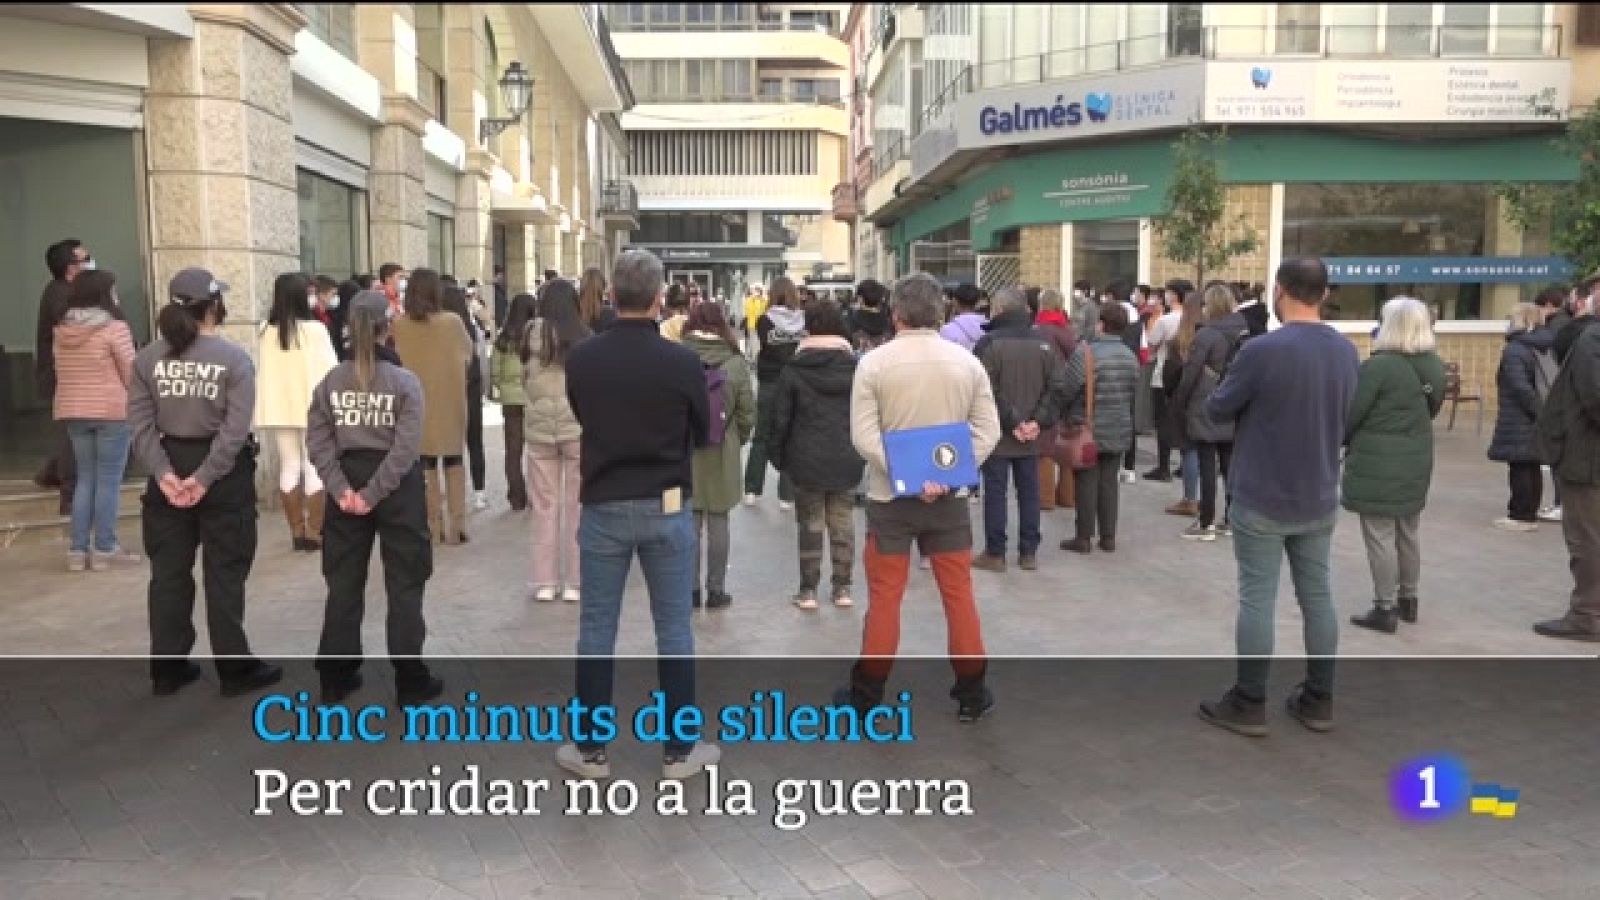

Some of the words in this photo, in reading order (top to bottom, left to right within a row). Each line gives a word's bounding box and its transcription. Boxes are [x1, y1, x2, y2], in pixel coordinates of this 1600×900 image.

[980, 95, 1082, 136] Galmés
[1115, 104, 1171, 121] DENTAL
[1237, 105, 1256, 116] 971
[153, 360, 226, 381] AGENT
[157, 379, 218, 400] COVID
[329, 391, 396, 412] AGENT
[334, 409, 396, 427] COVID
